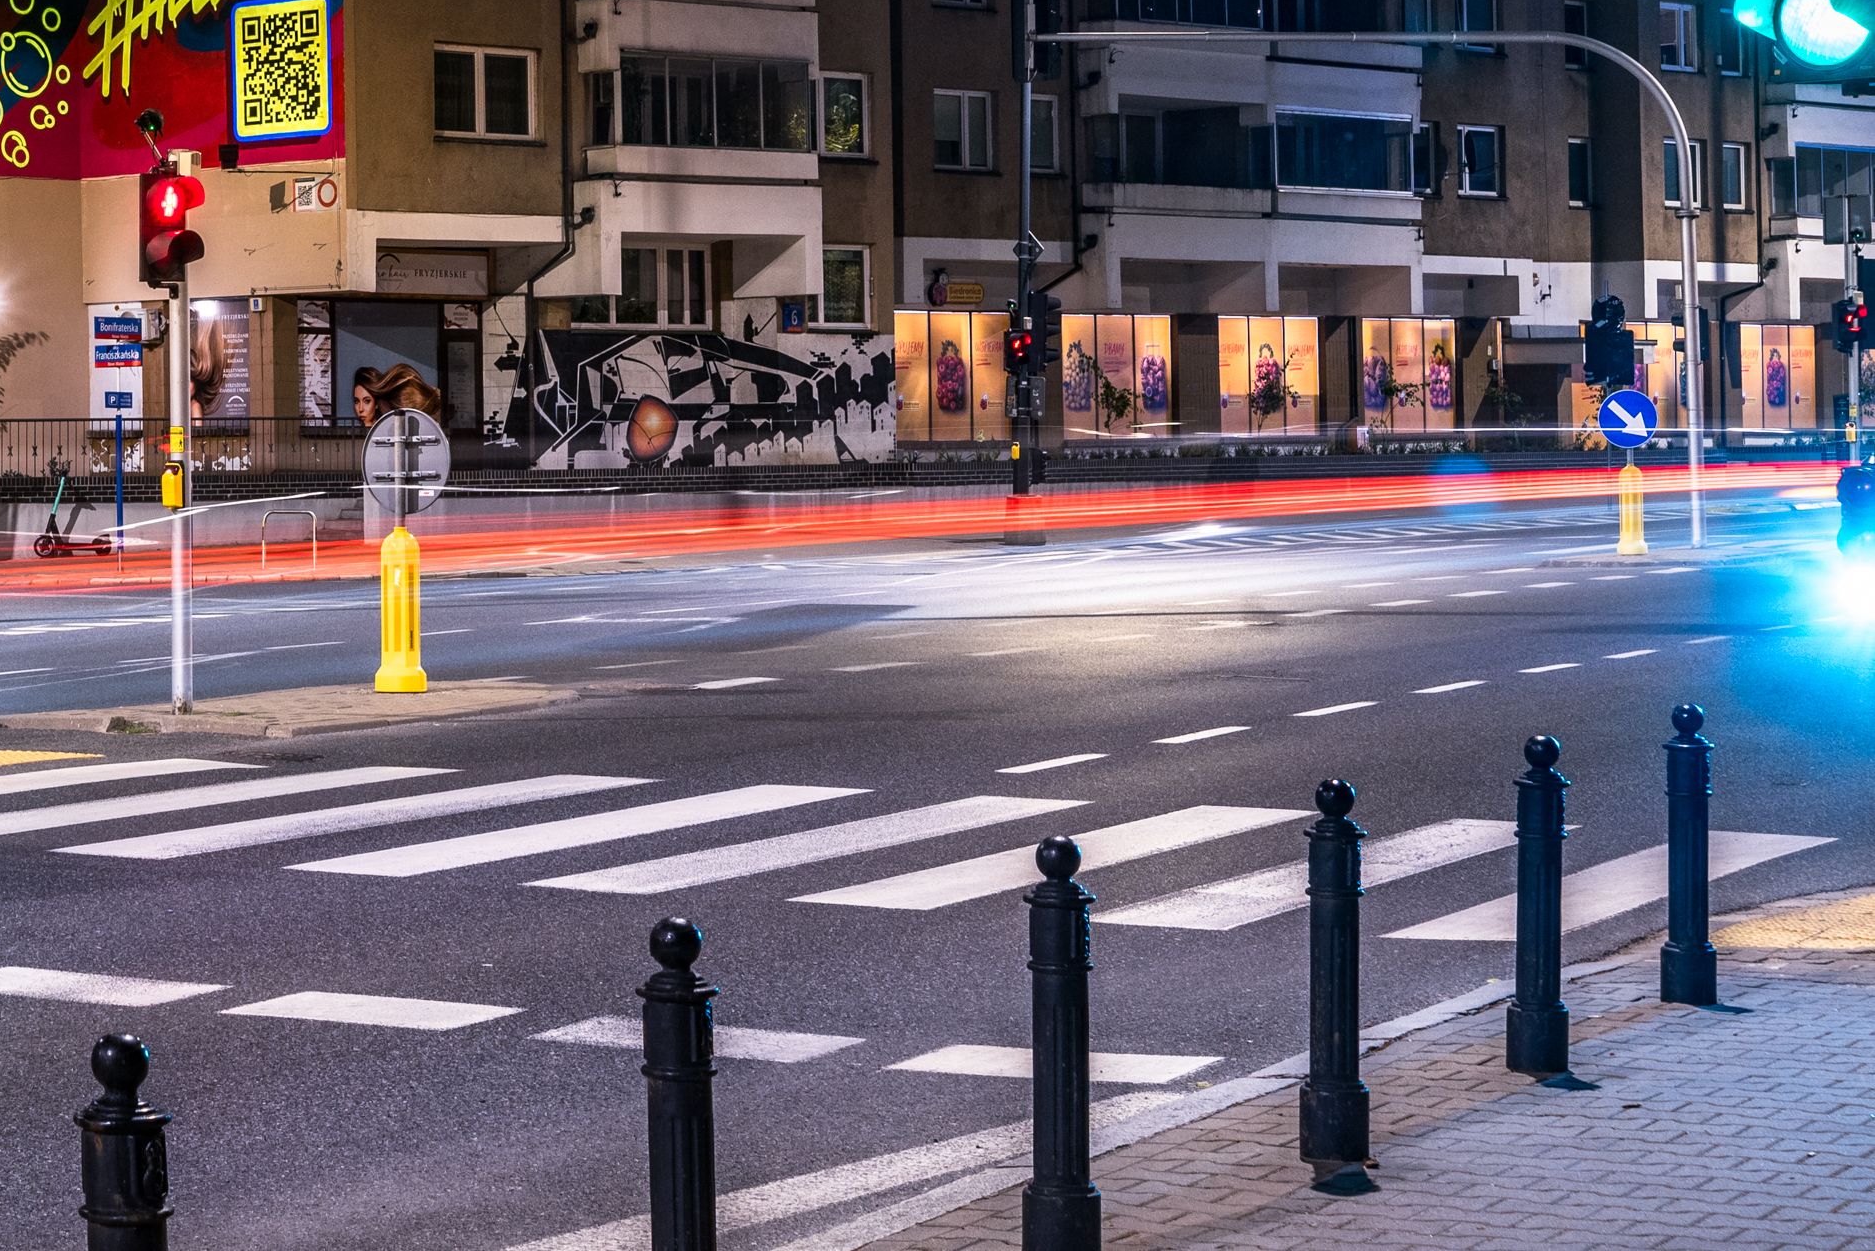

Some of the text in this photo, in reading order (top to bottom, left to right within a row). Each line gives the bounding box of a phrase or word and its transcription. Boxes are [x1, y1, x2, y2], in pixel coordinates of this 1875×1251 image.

[414, 268, 467, 279] FRYZJERSKIE
[791, 310, 798, 325] 6
[99, 322, 139, 333] Bonifraterska
[95, 350, 140, 360] Franciszkańska
